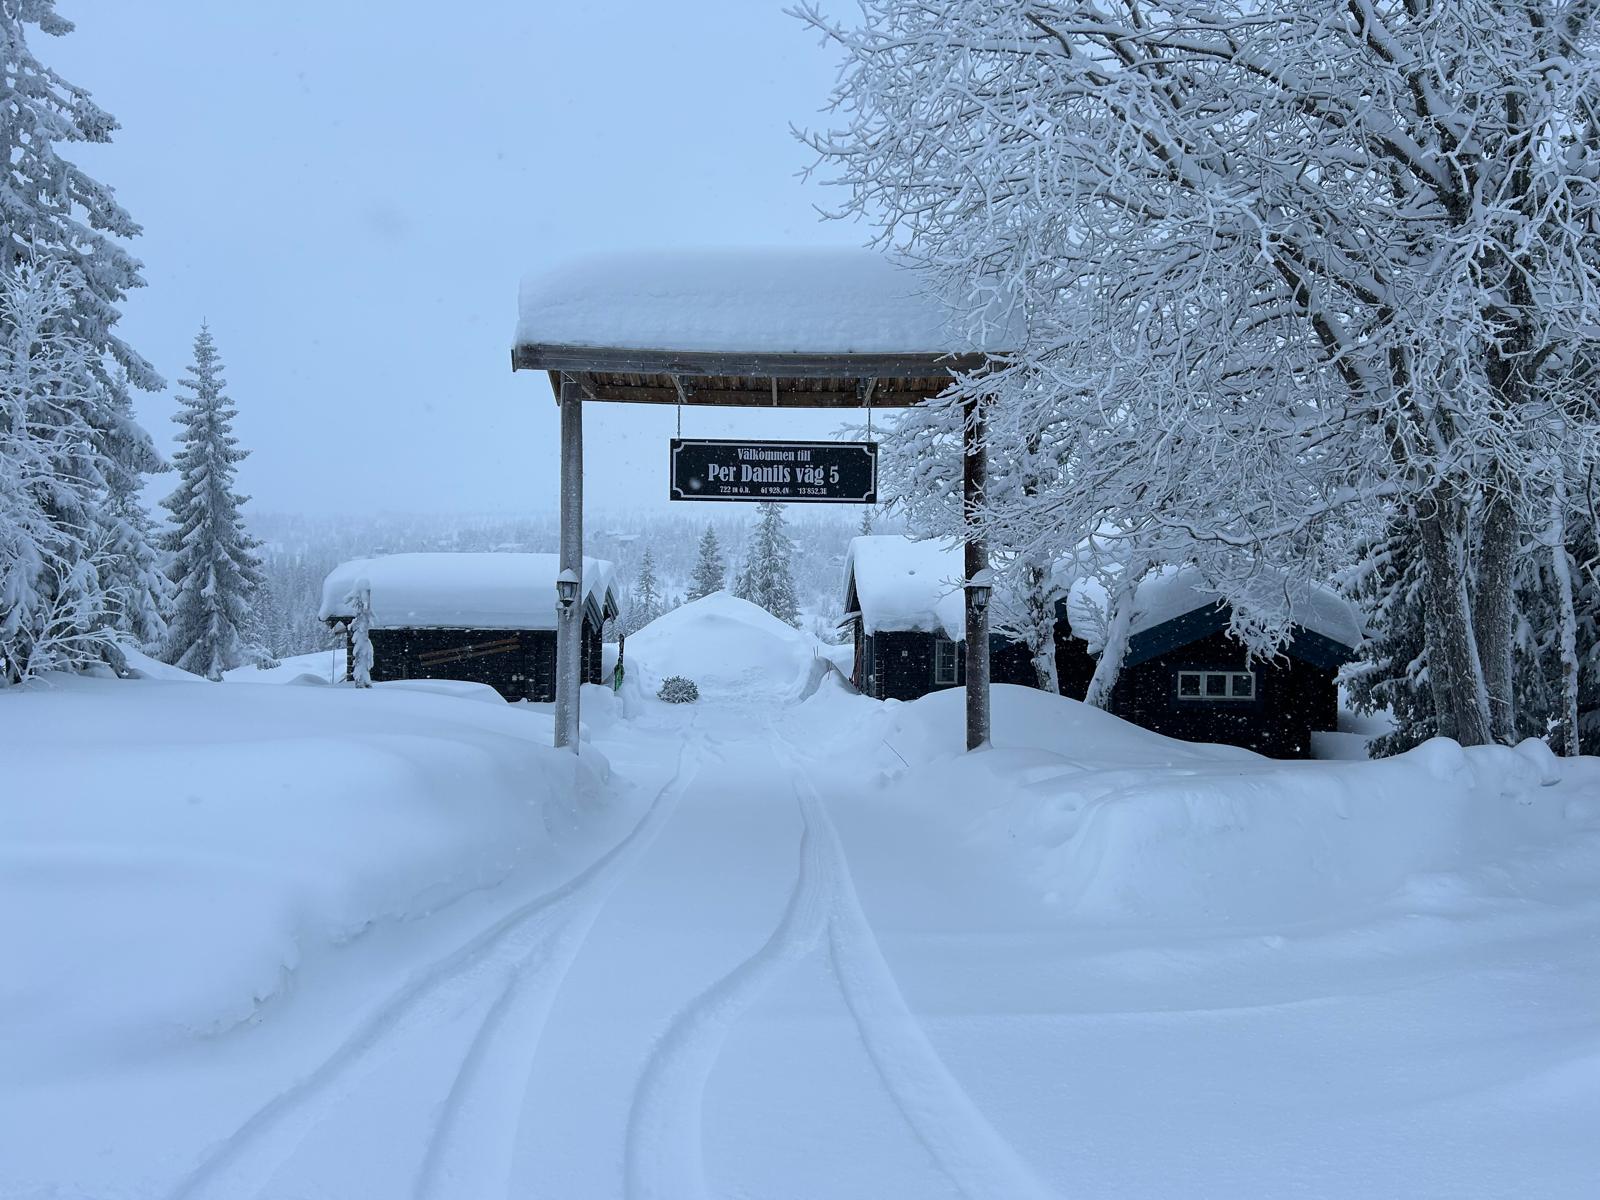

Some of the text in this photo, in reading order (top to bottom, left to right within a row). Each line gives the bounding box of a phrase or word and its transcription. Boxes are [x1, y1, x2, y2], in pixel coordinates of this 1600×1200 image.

[738, 448, 811, 461] Välkommen till
[708, 463, 840, 485] Per Danils väg 5
[719, 485, 732, 494] 722
